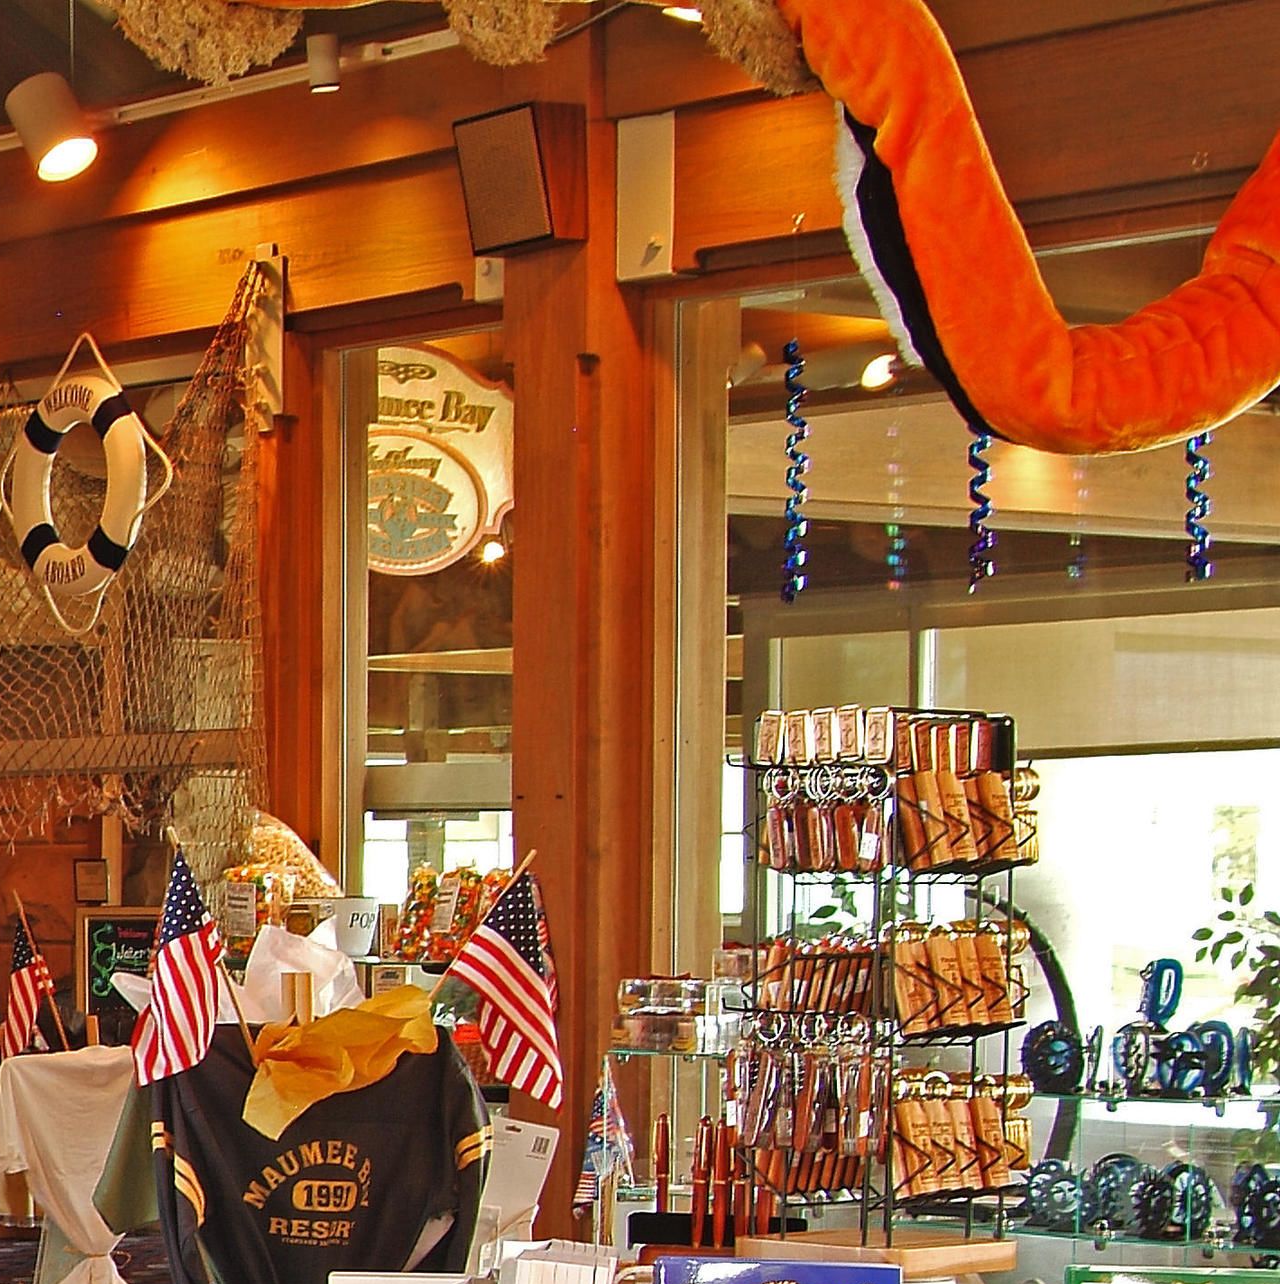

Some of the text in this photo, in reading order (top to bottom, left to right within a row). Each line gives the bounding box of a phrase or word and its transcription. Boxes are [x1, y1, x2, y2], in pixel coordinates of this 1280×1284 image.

[43, 384, 95, 416] WELCOME
[379, 390, 497, 433] mee Bay
[43, 554, 86, 586] ABOARD
[243, 1140, 359, 1210] MAUMEE
[303, 1183, 353, 1208] 1991
[268, 1217, 356, 1238] RESR
